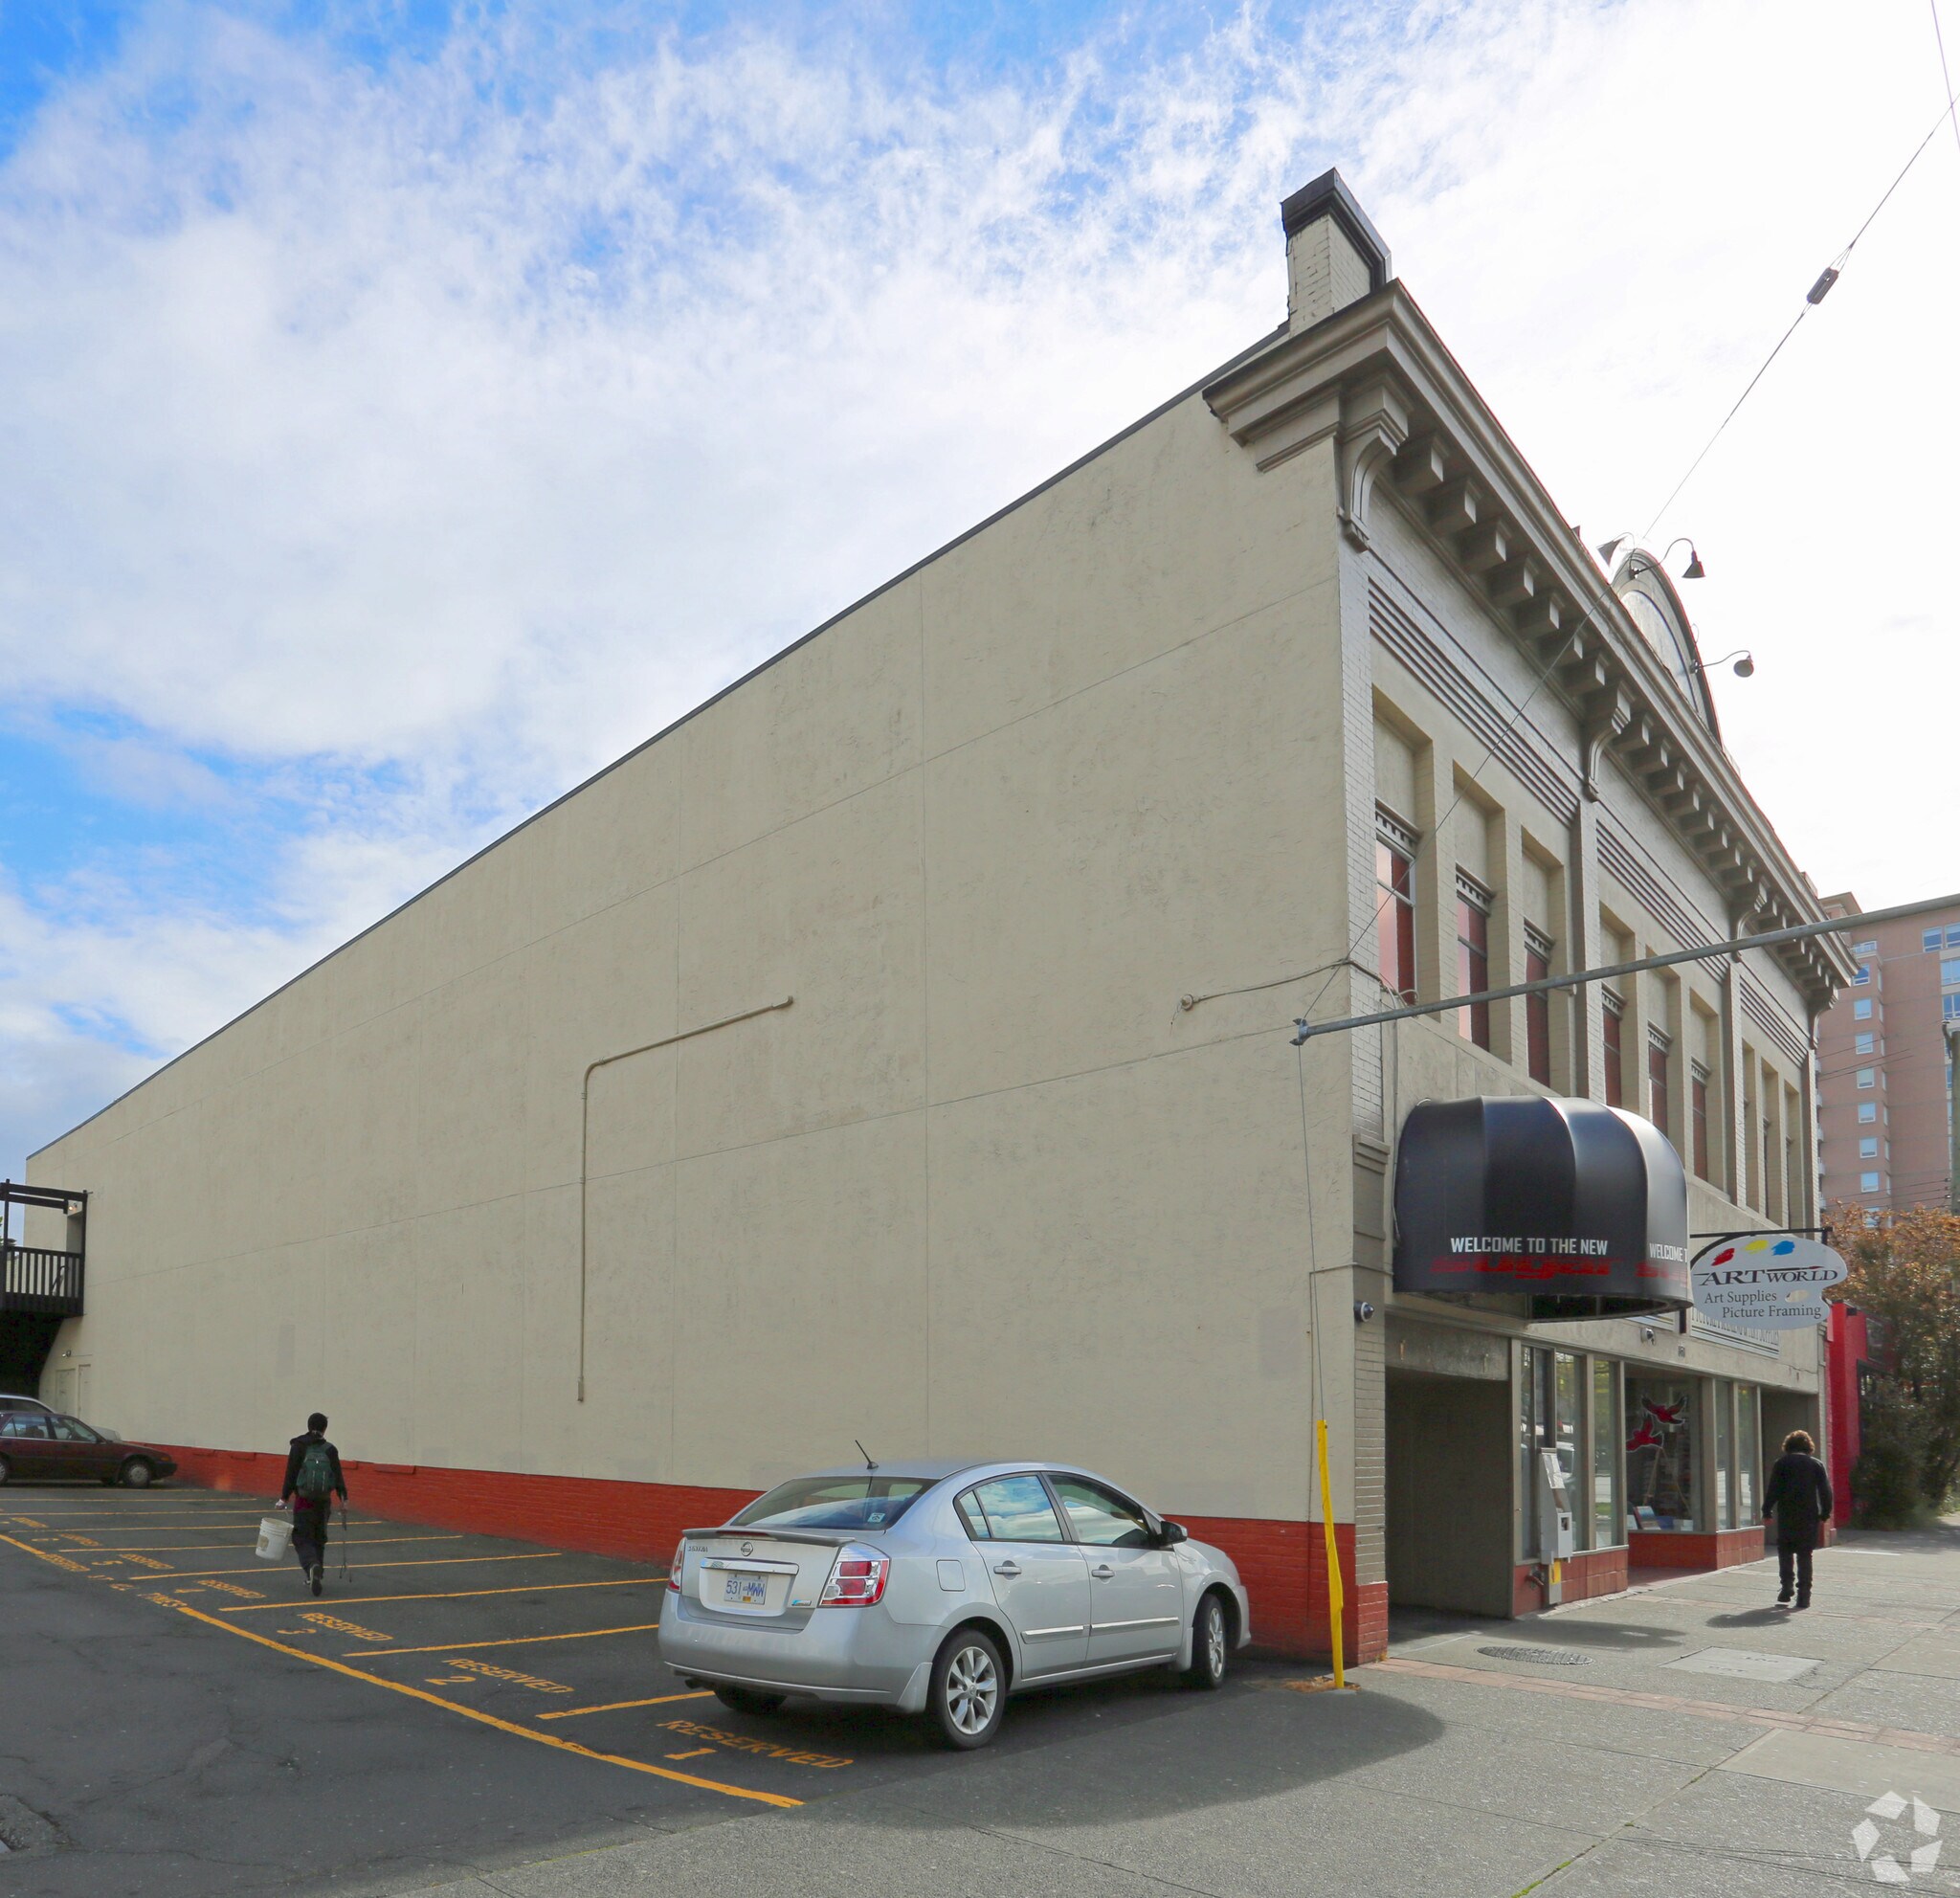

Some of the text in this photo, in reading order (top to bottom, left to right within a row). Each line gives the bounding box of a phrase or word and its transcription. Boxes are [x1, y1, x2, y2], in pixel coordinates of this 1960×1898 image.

[1450, 1237, 1609, 1256] WELCOME TO THE NEW
[1649, 1242, 1684, 1262] WELCOME
[1704, 1290, 1777, 1306] Art Supplies
[1723, 1305, 1822, 1319] Picture Framing
[725, 1580, 743, 1596] 531
[297, 1612, 394, 1642] RESERVED
[424, 1675, 477, 1686] 2
[441, 1657, 575, 1694] RESERVED
[656, 1720, 855, 1770] RESERVED
[664, 1748, 718, 1760] 1
